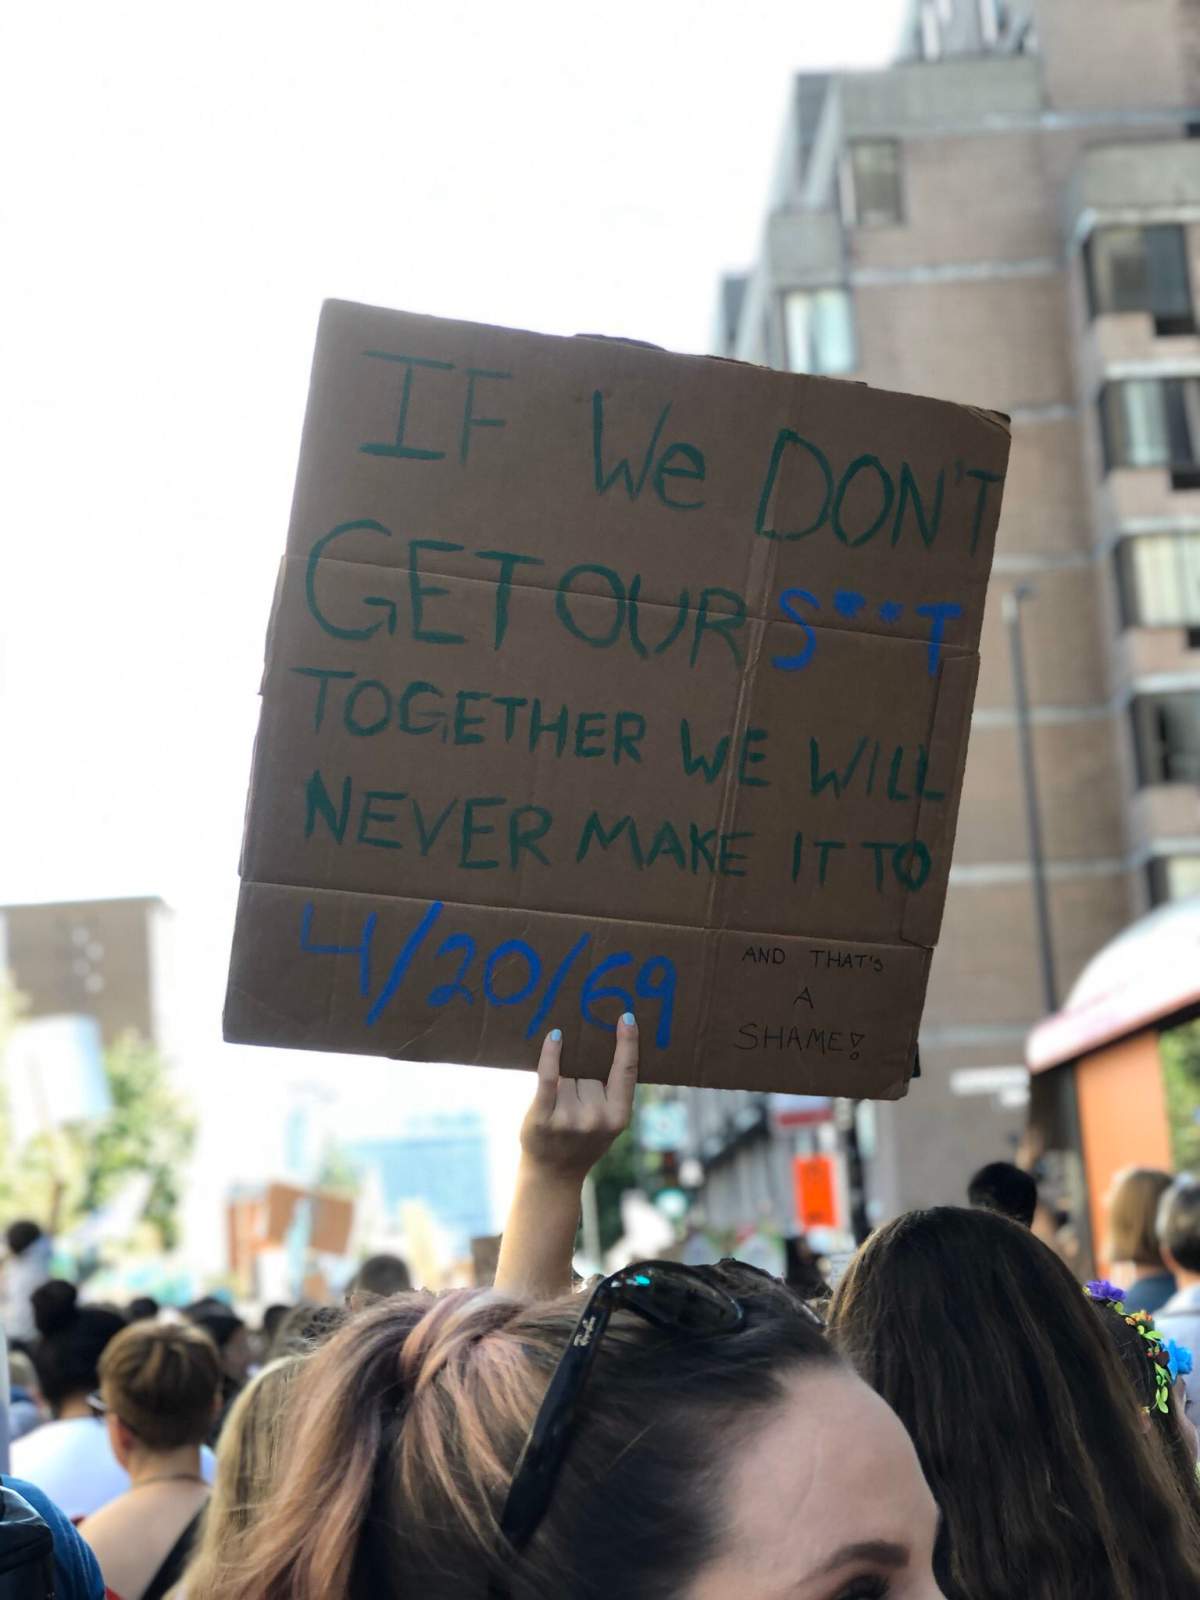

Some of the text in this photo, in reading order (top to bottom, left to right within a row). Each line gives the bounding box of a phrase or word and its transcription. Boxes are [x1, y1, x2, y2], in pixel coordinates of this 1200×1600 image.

[359, 349, 513, 465] IF
[756, 428, 1000, 557] DON'T
[306, 519, 544, 651] GET
[555, 563, 747, 668] OUR
[291, 667, 945, 800] TOGETHER WE WILL
[303, 770, 932, 893] NEVER MAKE IT TO
[300, 900, 676, 1050] 4/20/69
[742, 946, 786, 965] AND
[793, 986, 815, 1009] A
